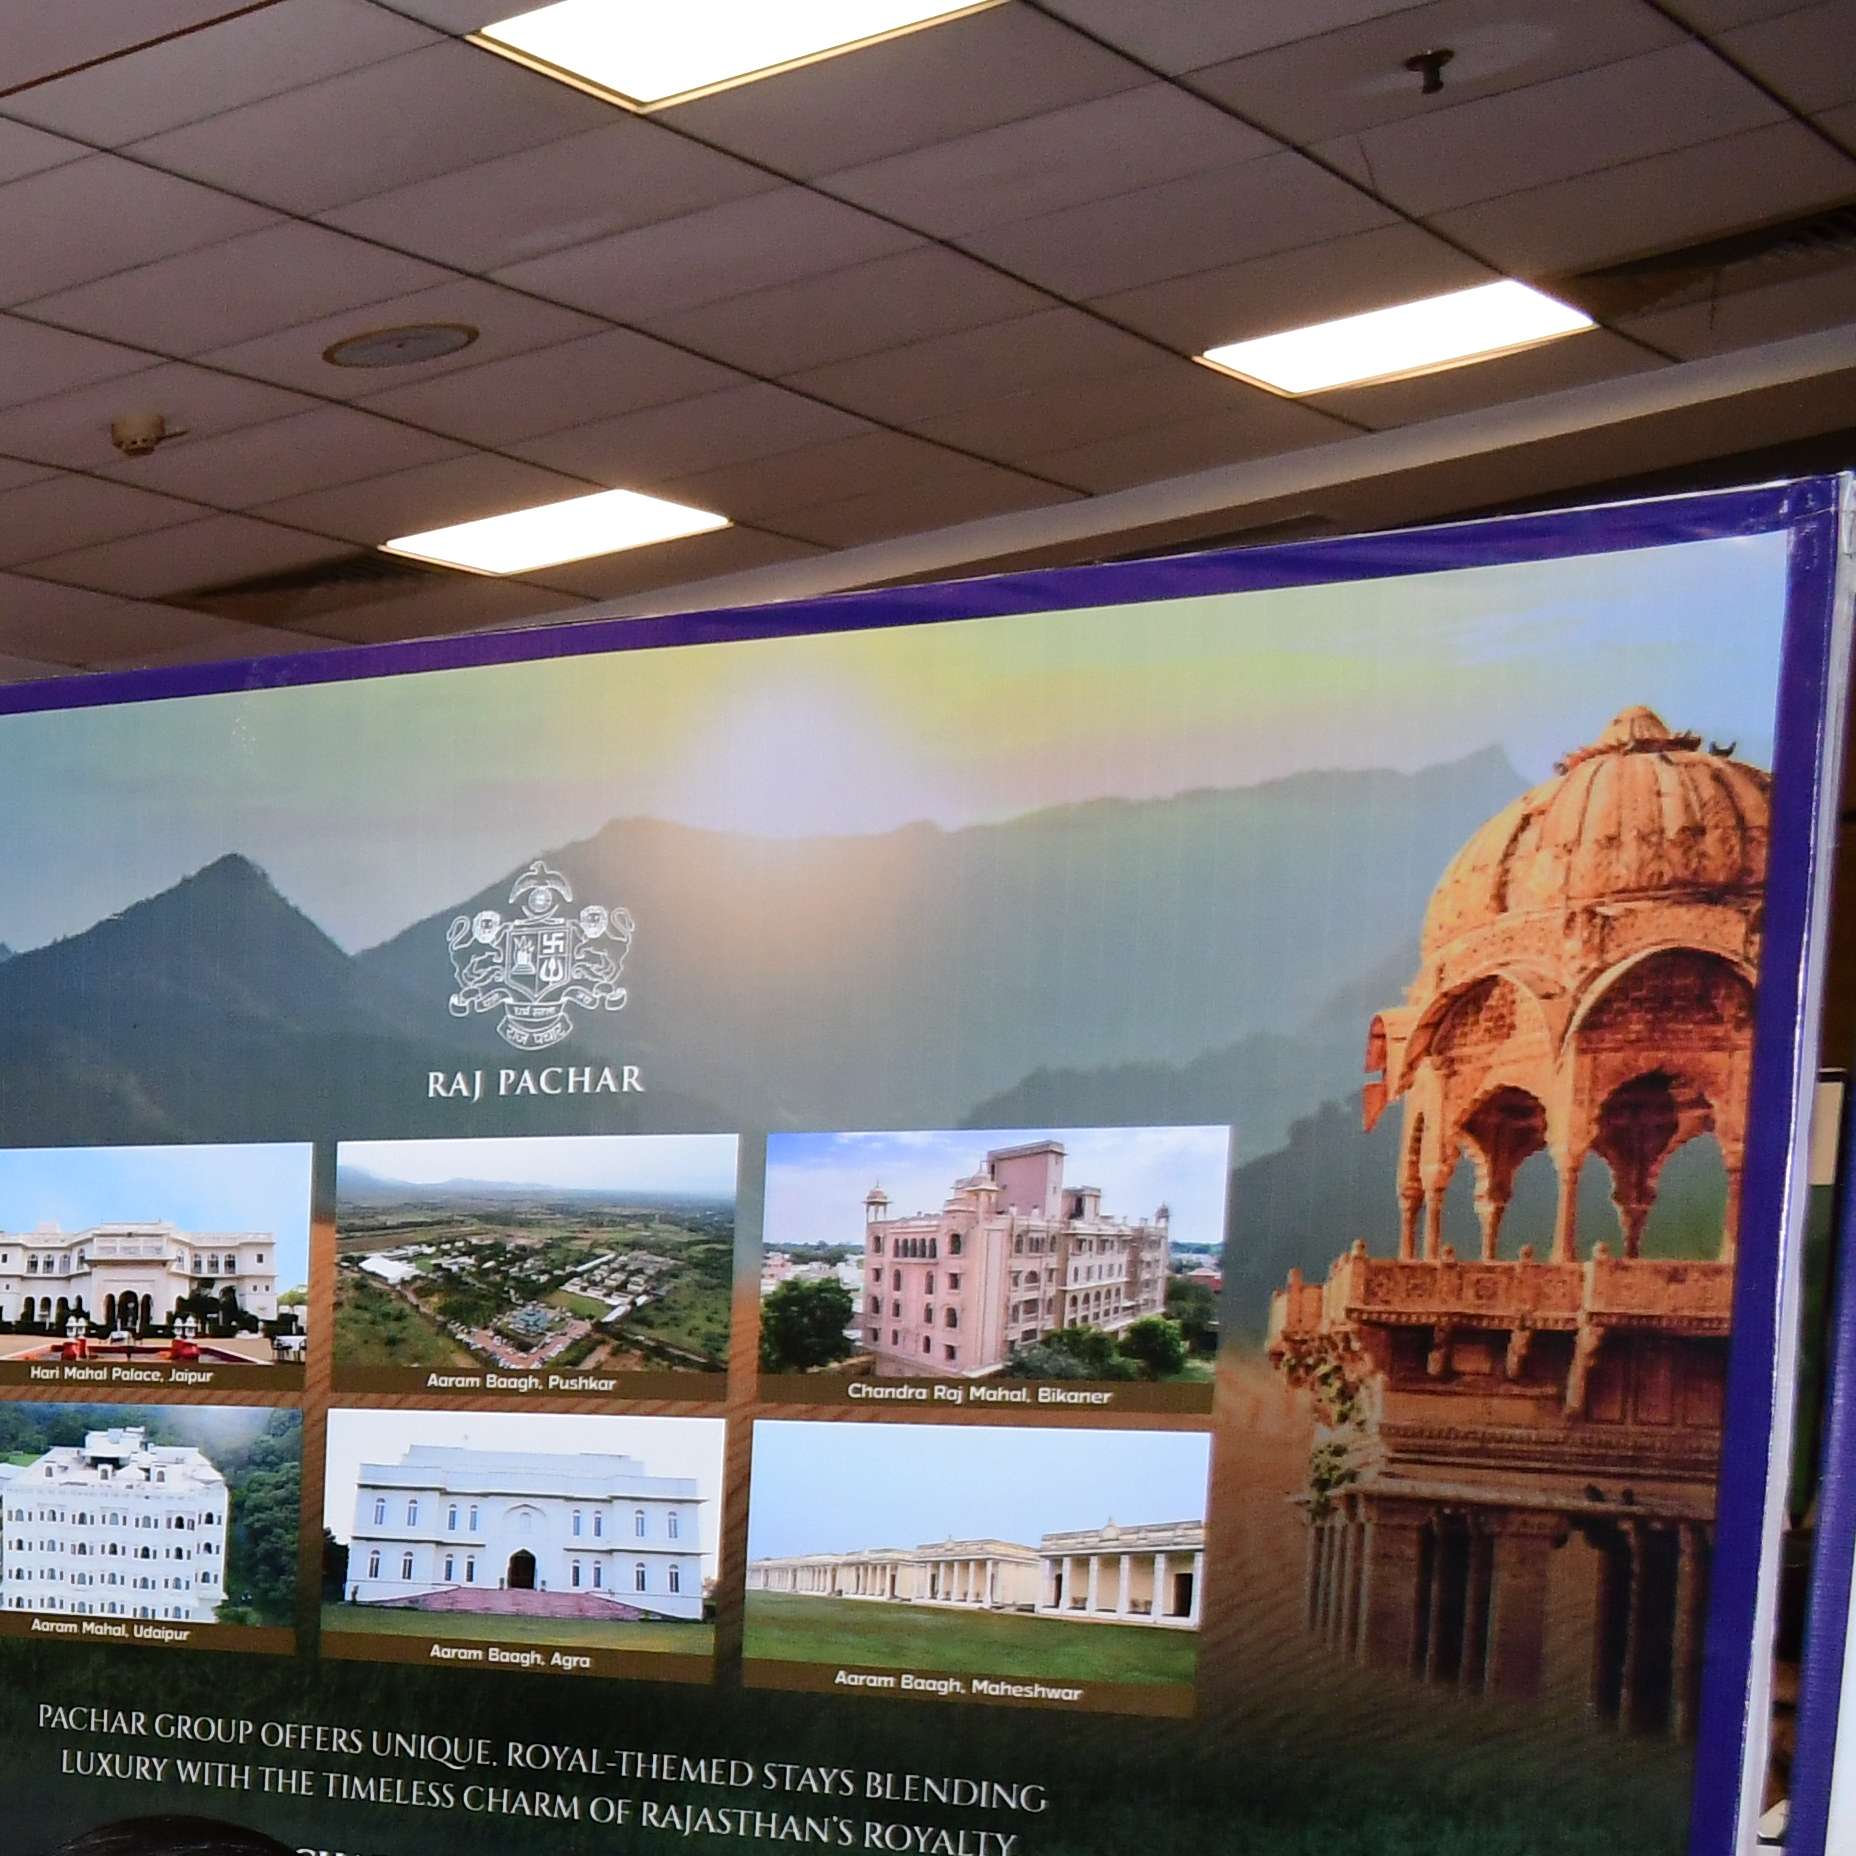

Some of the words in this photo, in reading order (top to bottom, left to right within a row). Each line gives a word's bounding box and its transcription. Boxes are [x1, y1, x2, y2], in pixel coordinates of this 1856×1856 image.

[427, 1070, 483, 1102] RAJ
[498, 1065, 645, 1097] PACHAR
[29, 1364, 62, 1381] Hari
[63, 1365, 107, 1382] Mahal
[111, 1366, 165, 1384] Palace,
[168, 1367, 214, 1386] Jaipur
[426, 1373, 482, 1389] Aaram
[547, 1374, 618, 1392] Pushkar
[847, 1382, 927, 1400] Chandra
[932, 1384, 964, 1404] Raj
[1037, 1387, 1114, 1406] Bikaner
[30, 1617, 78, 1634] Aaram
[132, 1624, 191, 1644] Udaipur
[429, 1643, 483, 1662] Aaram
[550, 1651, 592, 1671] Agra
[833, 1669, 895, 1689] Aaram
[971, 1678, 1084, 1702] Maheshwar
[38, 1703, 148, 1737] PACHAR
[154, 1713, 254, 1745] GROUP
[261, 1721, 363, 1755] OFFERS
[507, 1741, 753, 1788] ROYAL-THEMED
[762, 1762, 855, 1798] STAYS
[865, 1772, 1048, 1813] BLENDING
[60, 1749, 168, 1782] LUXURY
[176, 1759, 253, 1791] WITH
[258, 1766, 315, 1797] THE
[321, 1771, 456, 1809] TIMELESS
[462, 1784, 581, 1820] CHARM
[589, 1796, 632, 1826] OF
[640, 1801, 855, 1847] RAJASTHAN'S
